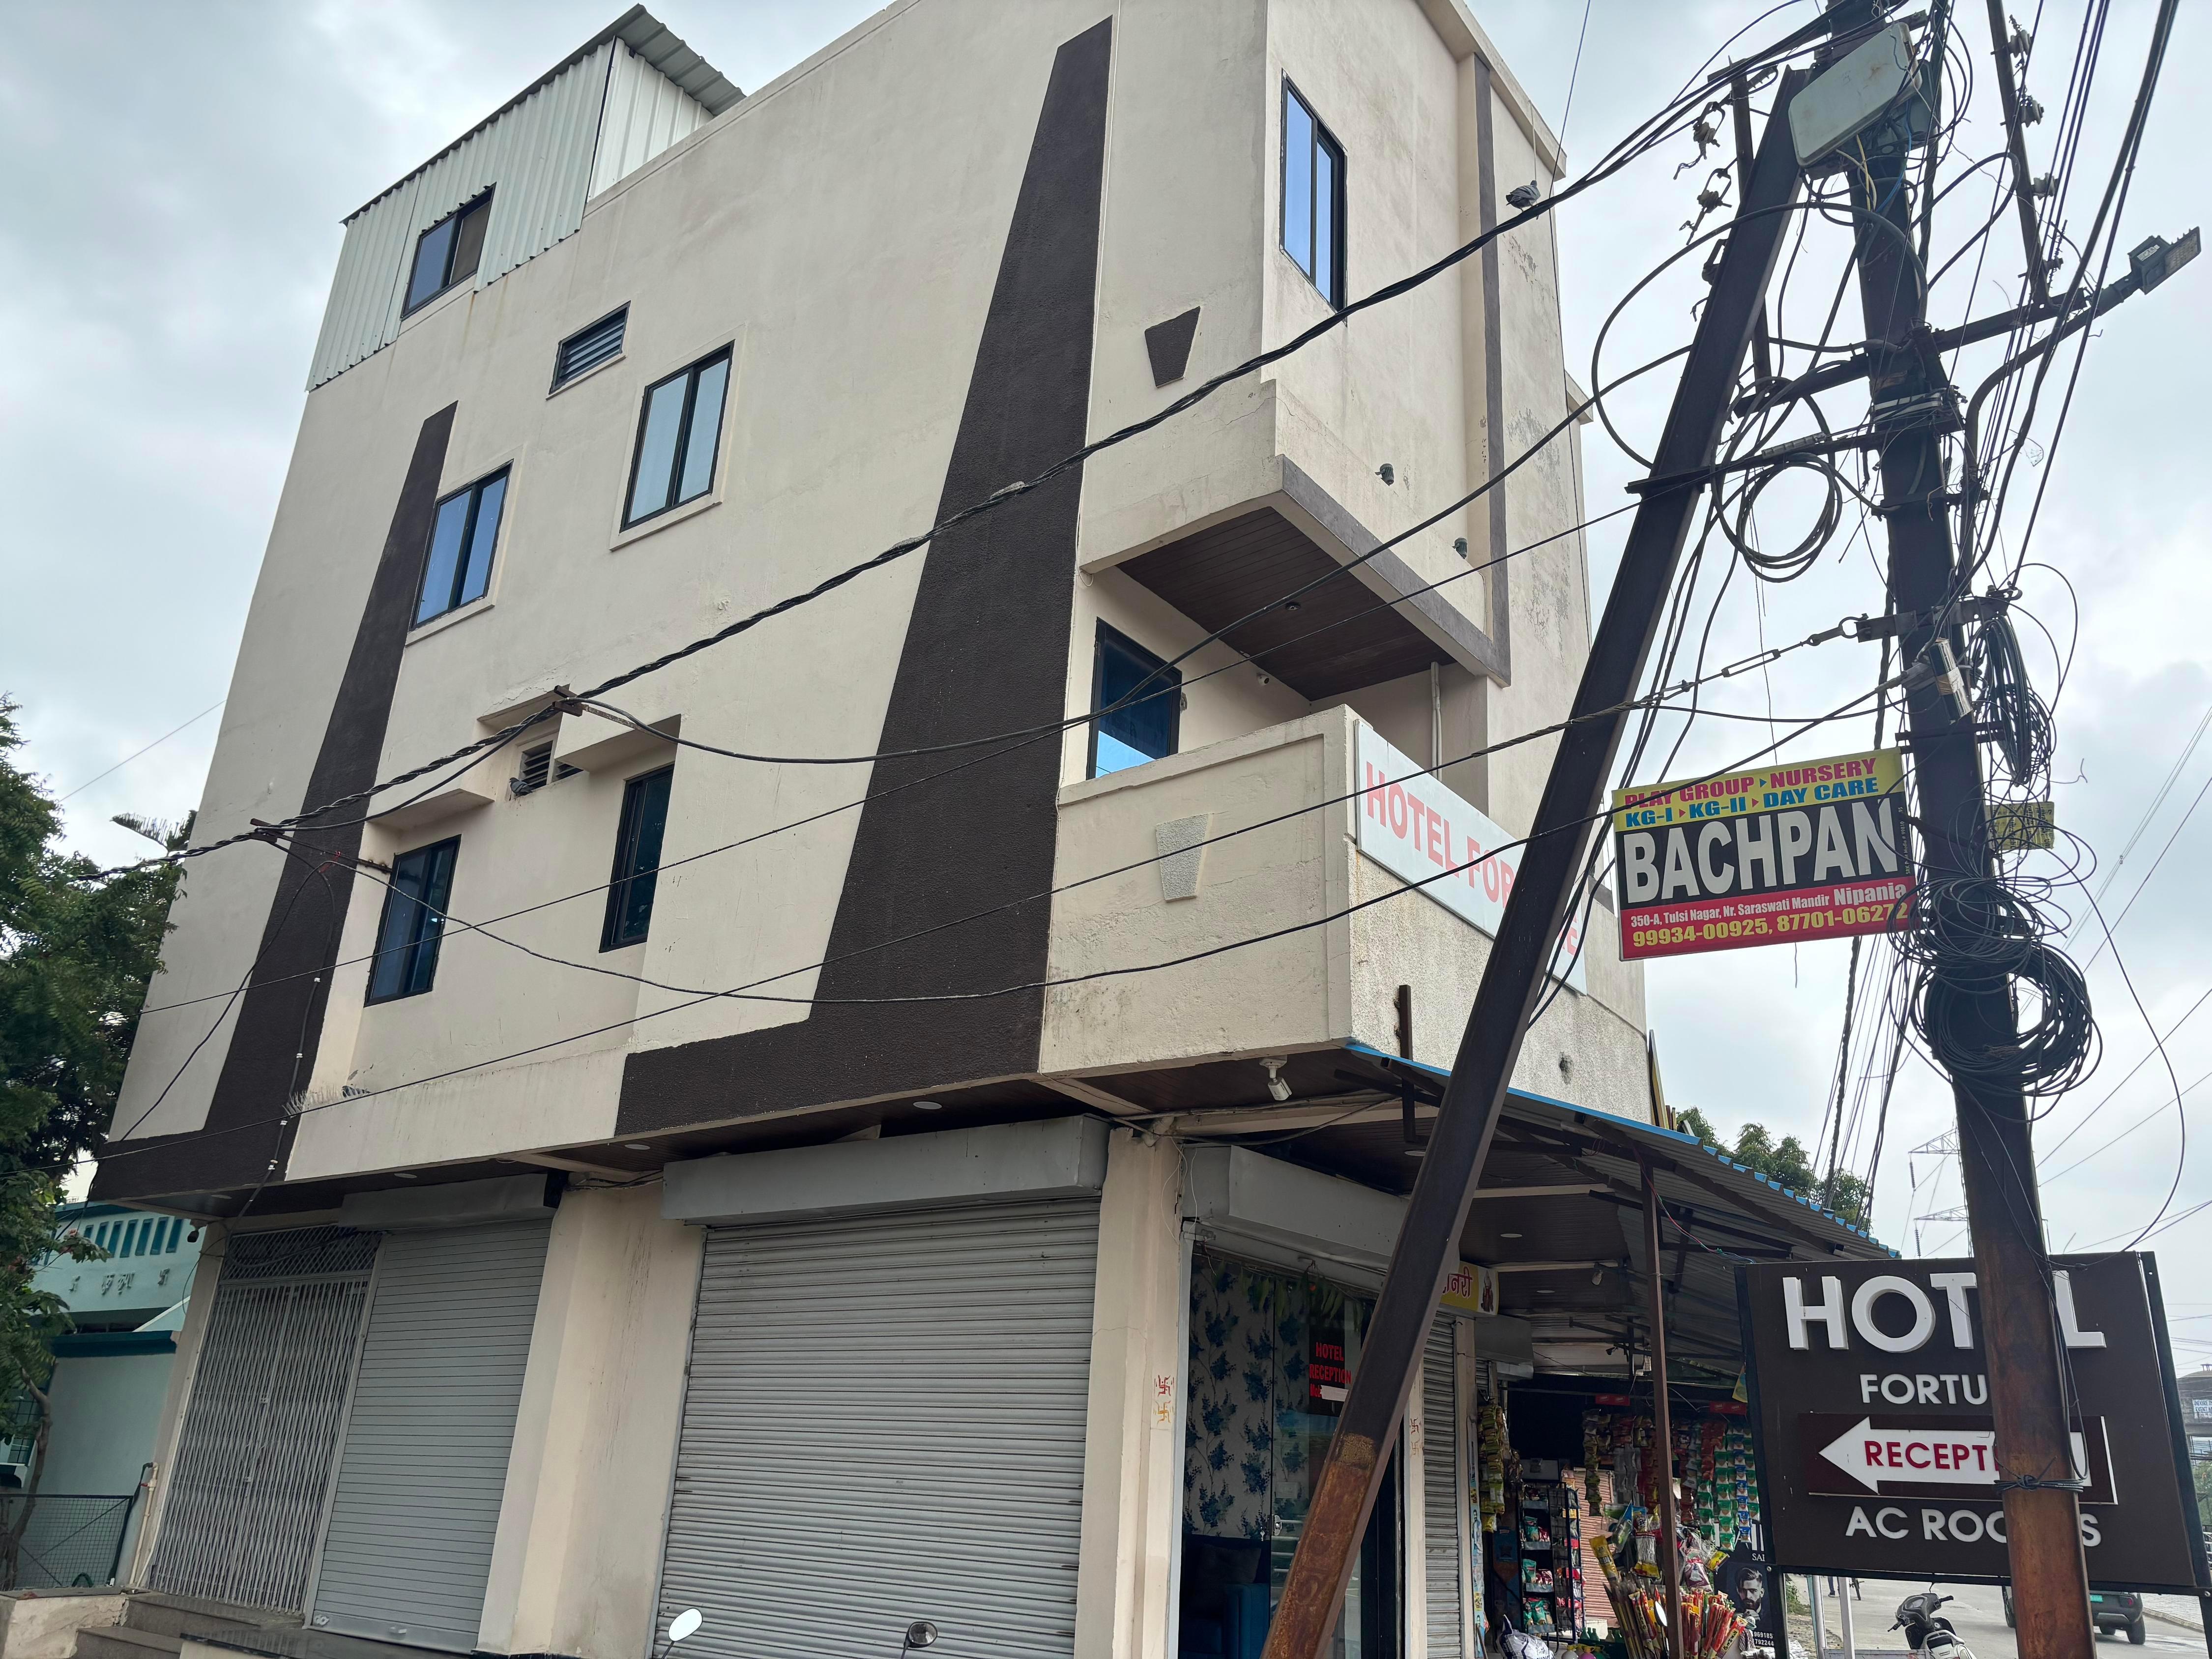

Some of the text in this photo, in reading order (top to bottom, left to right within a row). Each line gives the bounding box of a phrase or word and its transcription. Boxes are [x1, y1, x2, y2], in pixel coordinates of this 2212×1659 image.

[1625, 757, 1876, 810] PLAY GROUP NURSERY
[1626, 777, 1879, 828] KG-I KG-II DAY CARE
[1367, 761, 1459, 878] HOTEL
[1624, 797, 1898, 903] BACHPAN
[1631, 882, 1907, 928] 350-A, Tulsi Nagar, Nr. Saraswati Mandir Nipania
[1633, 902, 1908, 947] 99934-00925, 87701-06272
[1782, 1270, 2106, 1353] HOTL
[1309, 1364, 1352, 1385] RECEPTION
[1315, 1342, 1344, 1362] HOTEL
[1860, 1373, 1988, 1405] FORTU
[1864, 1440, 1999, 1472] RECEPT
[1845, 1505, 2102, 1547] AC ROOS
[1753, 1631, 1774, 1639] 969185
